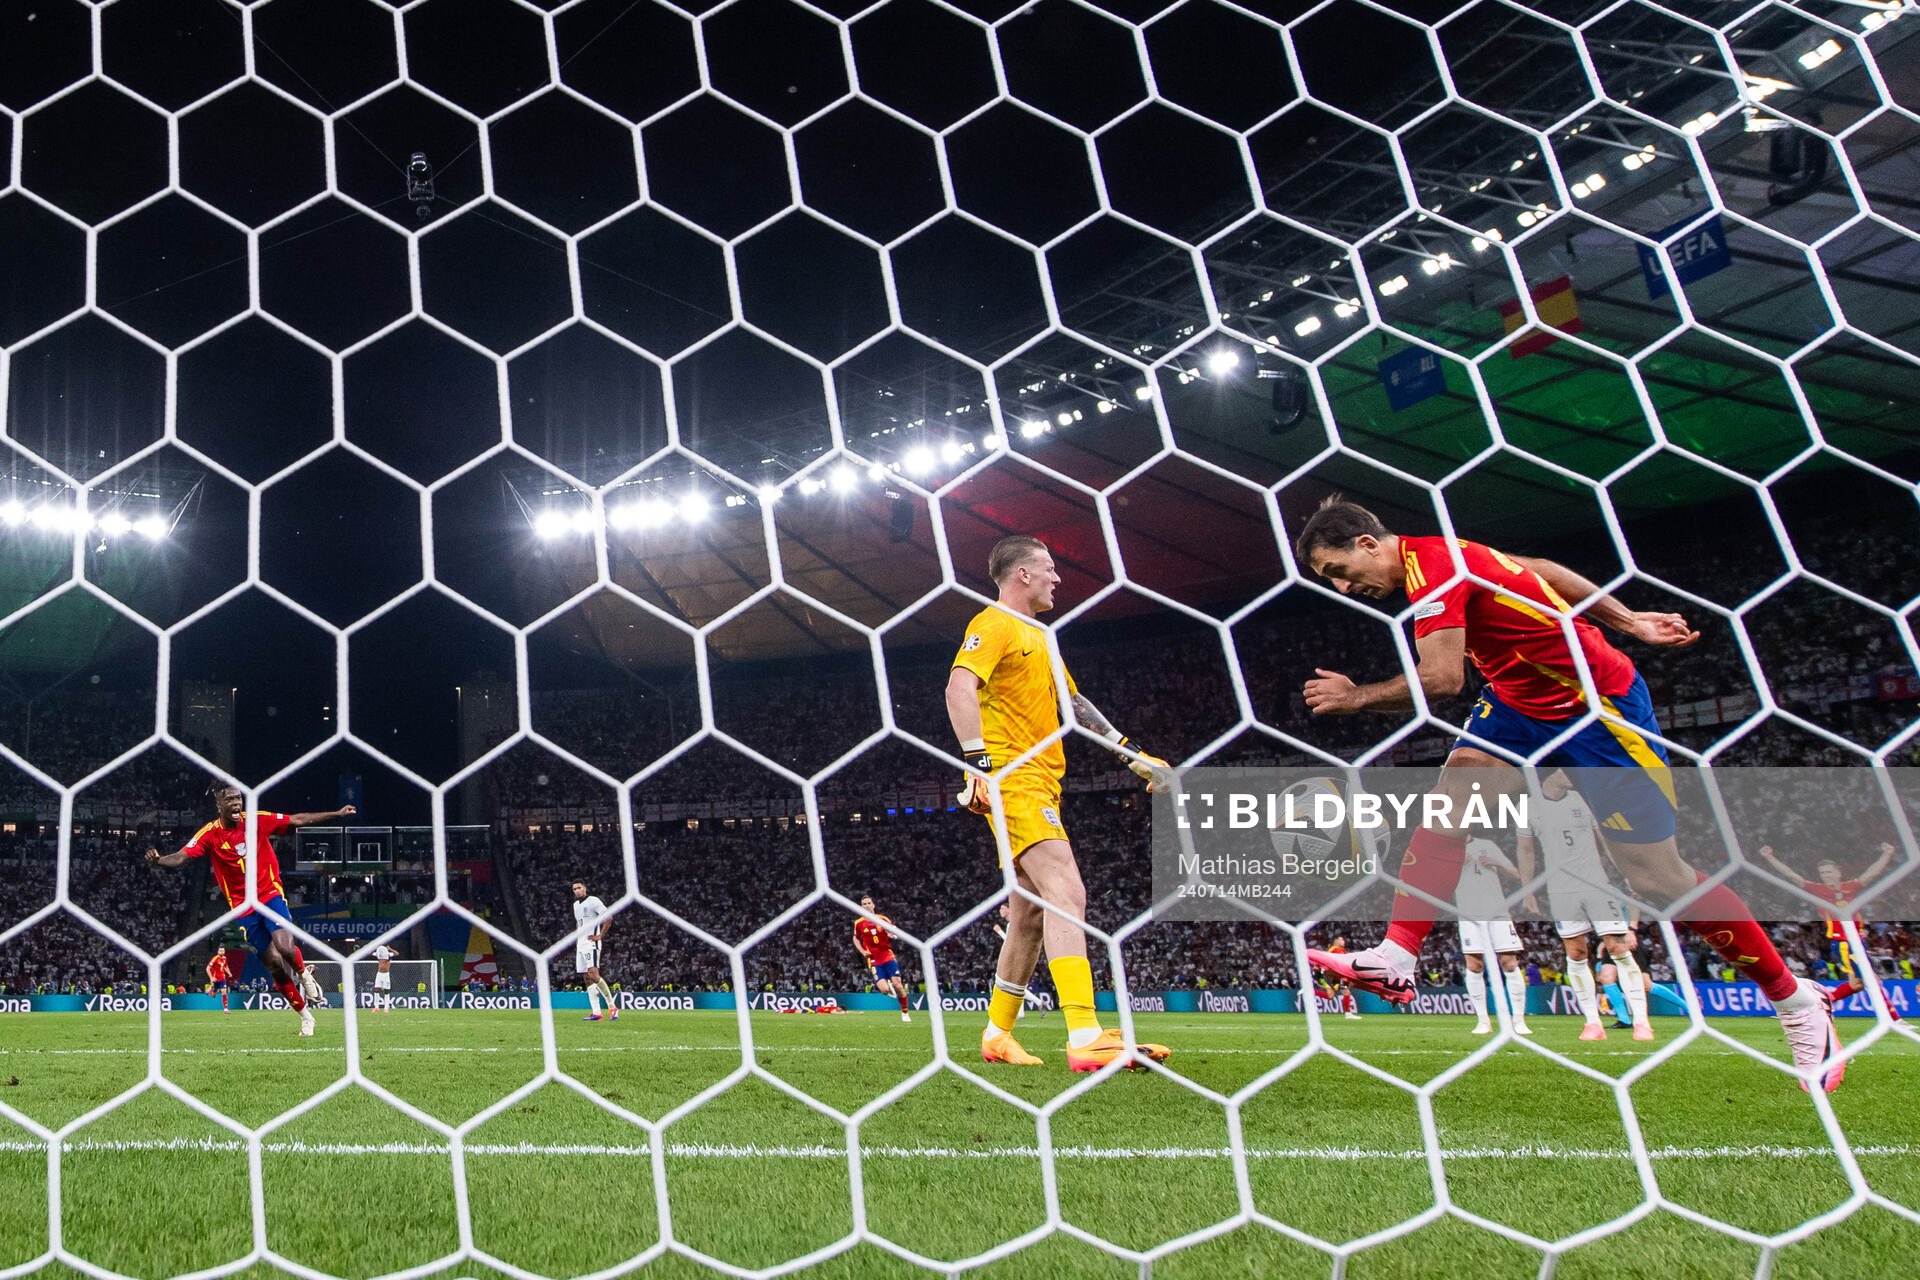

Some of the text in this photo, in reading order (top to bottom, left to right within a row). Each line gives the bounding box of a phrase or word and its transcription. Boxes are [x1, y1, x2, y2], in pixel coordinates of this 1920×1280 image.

[1648, 231, 1718, 276] UEFA
[1562, 830, 1574, 846] 5
[100, 994, 172, 1012] Rexoa
[461, 993, 531, 1010] Rexona
[620, 993, 694, 1011] Rexona
[941, 997, 988, 1011] exon
[1127, 992, 1164, 1011] Rexona
[1708, 986, 1773, 1012] UEFA
